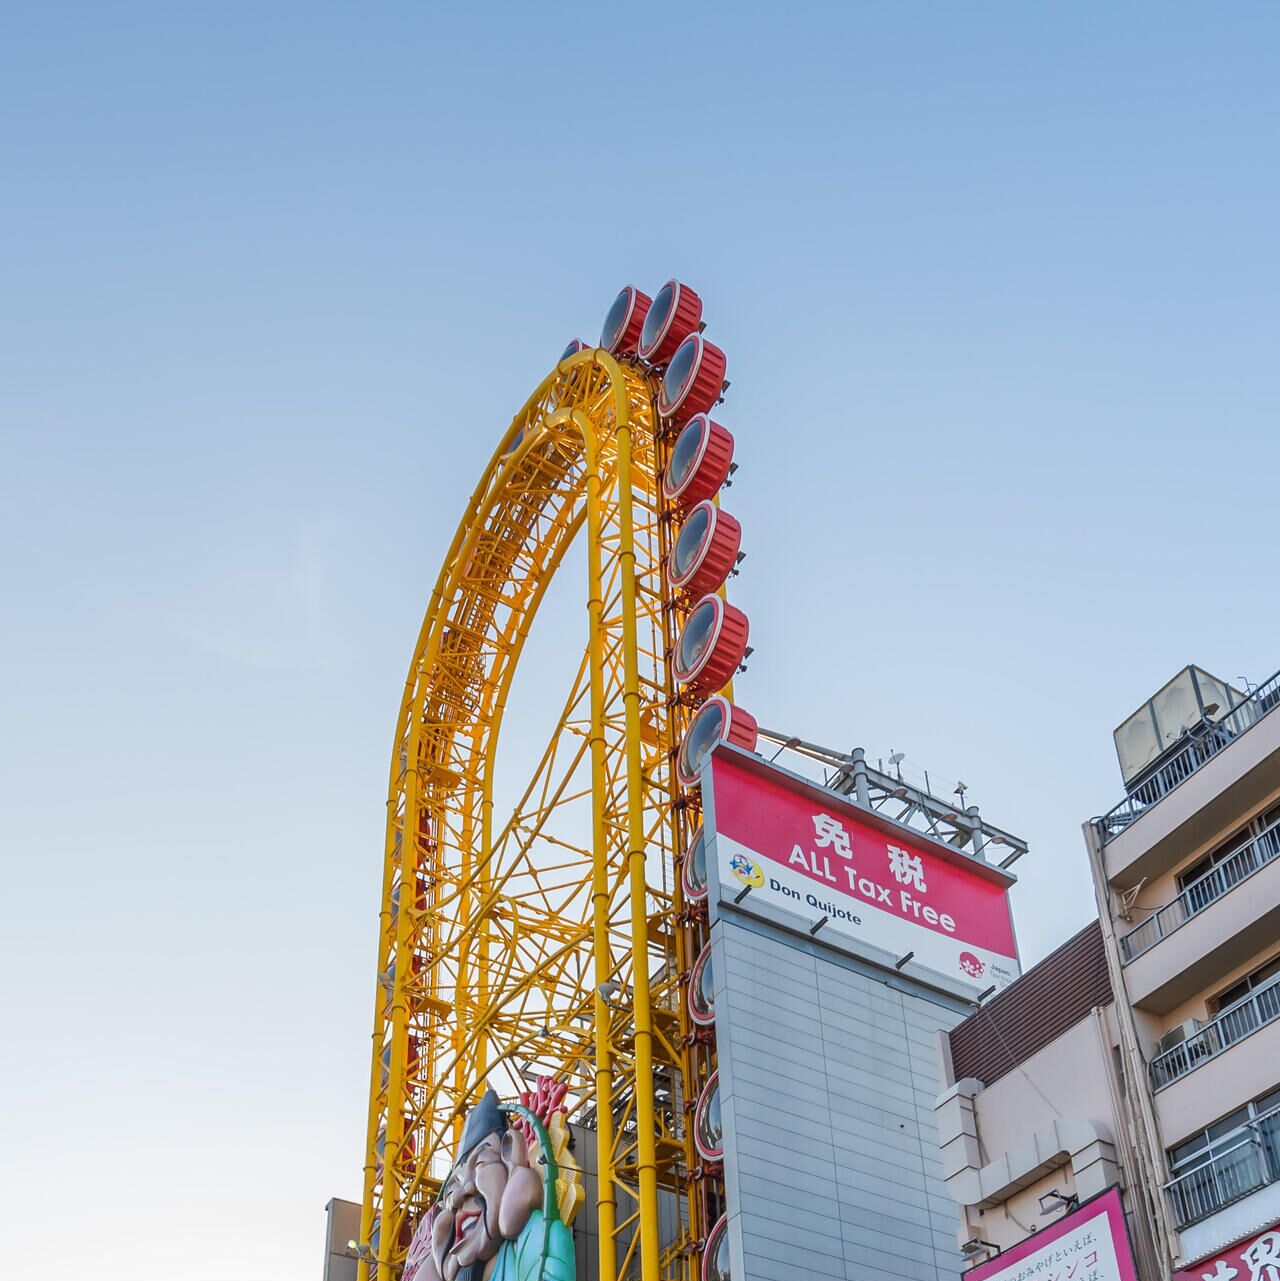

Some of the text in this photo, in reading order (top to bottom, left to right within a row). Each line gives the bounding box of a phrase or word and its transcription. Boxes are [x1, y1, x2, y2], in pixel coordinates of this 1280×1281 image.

[788, 843, 957, 933] ALL Tax Free
[810, 812, 928, 894] 免税
[769, 877, 862, 926] Don Quijote
